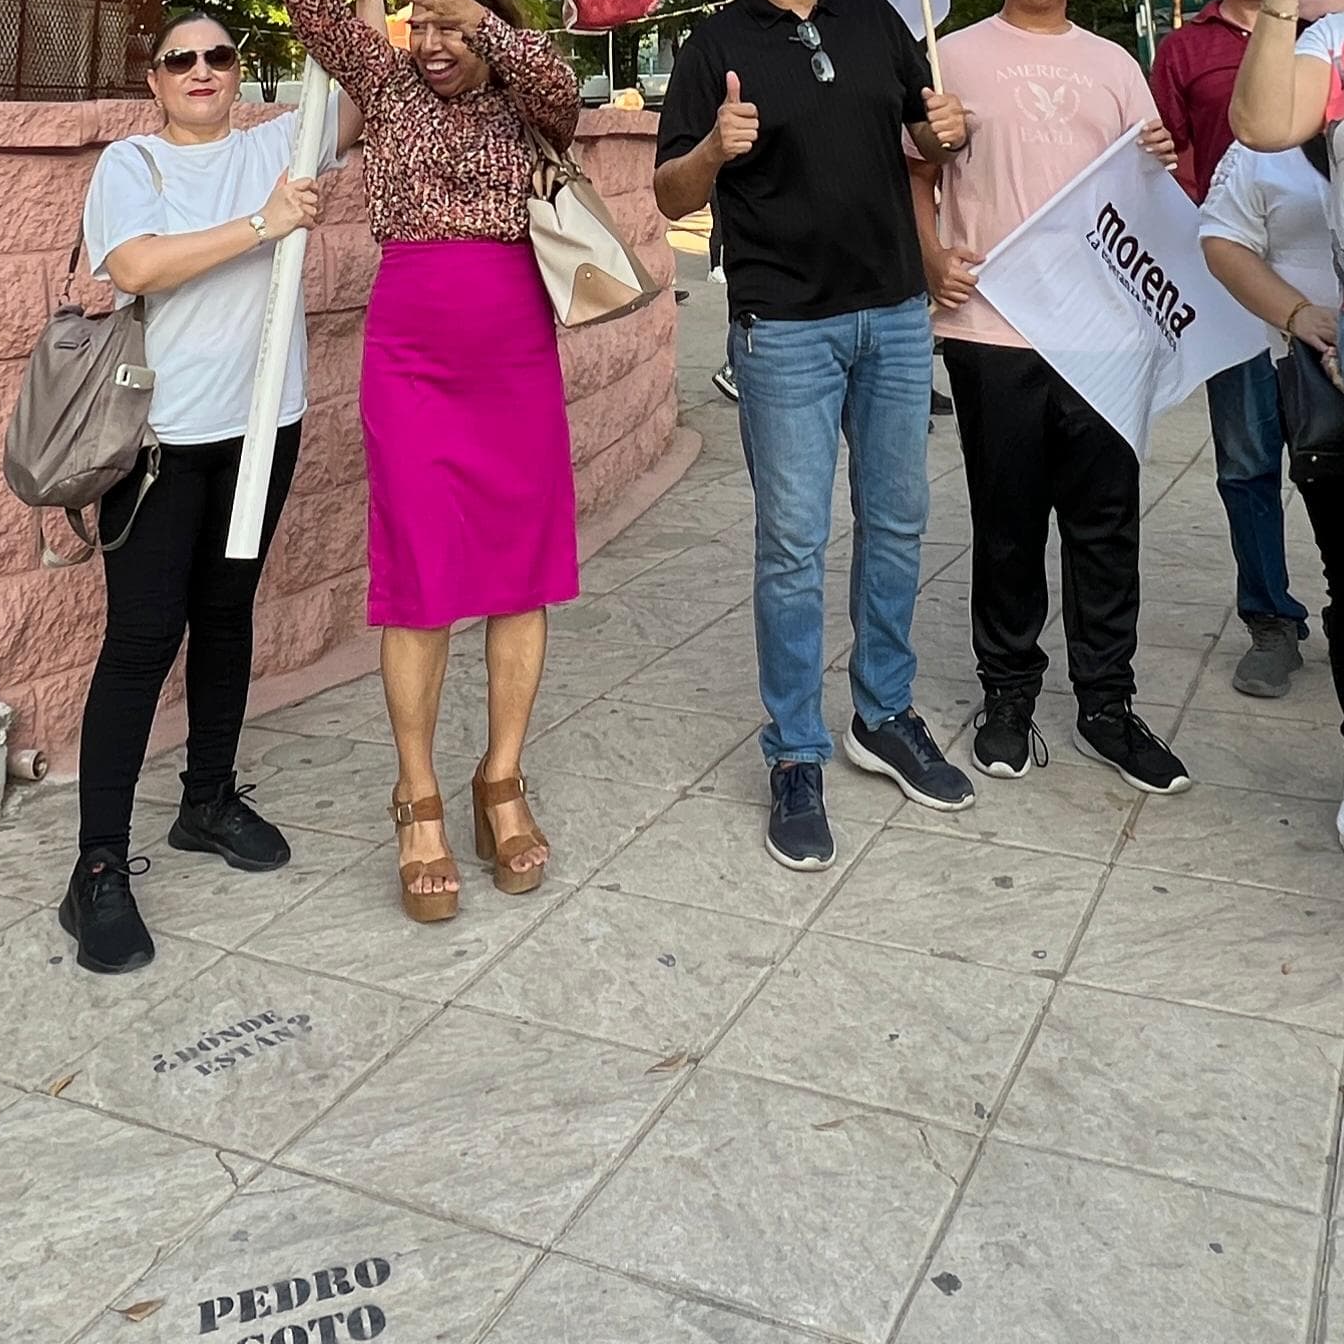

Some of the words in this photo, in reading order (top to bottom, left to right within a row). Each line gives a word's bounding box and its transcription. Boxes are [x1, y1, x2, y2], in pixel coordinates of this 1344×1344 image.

[995, 64, 1095, 89] AMERICAN
[1085, 230, 1101, 251] La
[1097, 202, 1196, 338] morena
[197, 1257, 391, 1335] PEDRO
